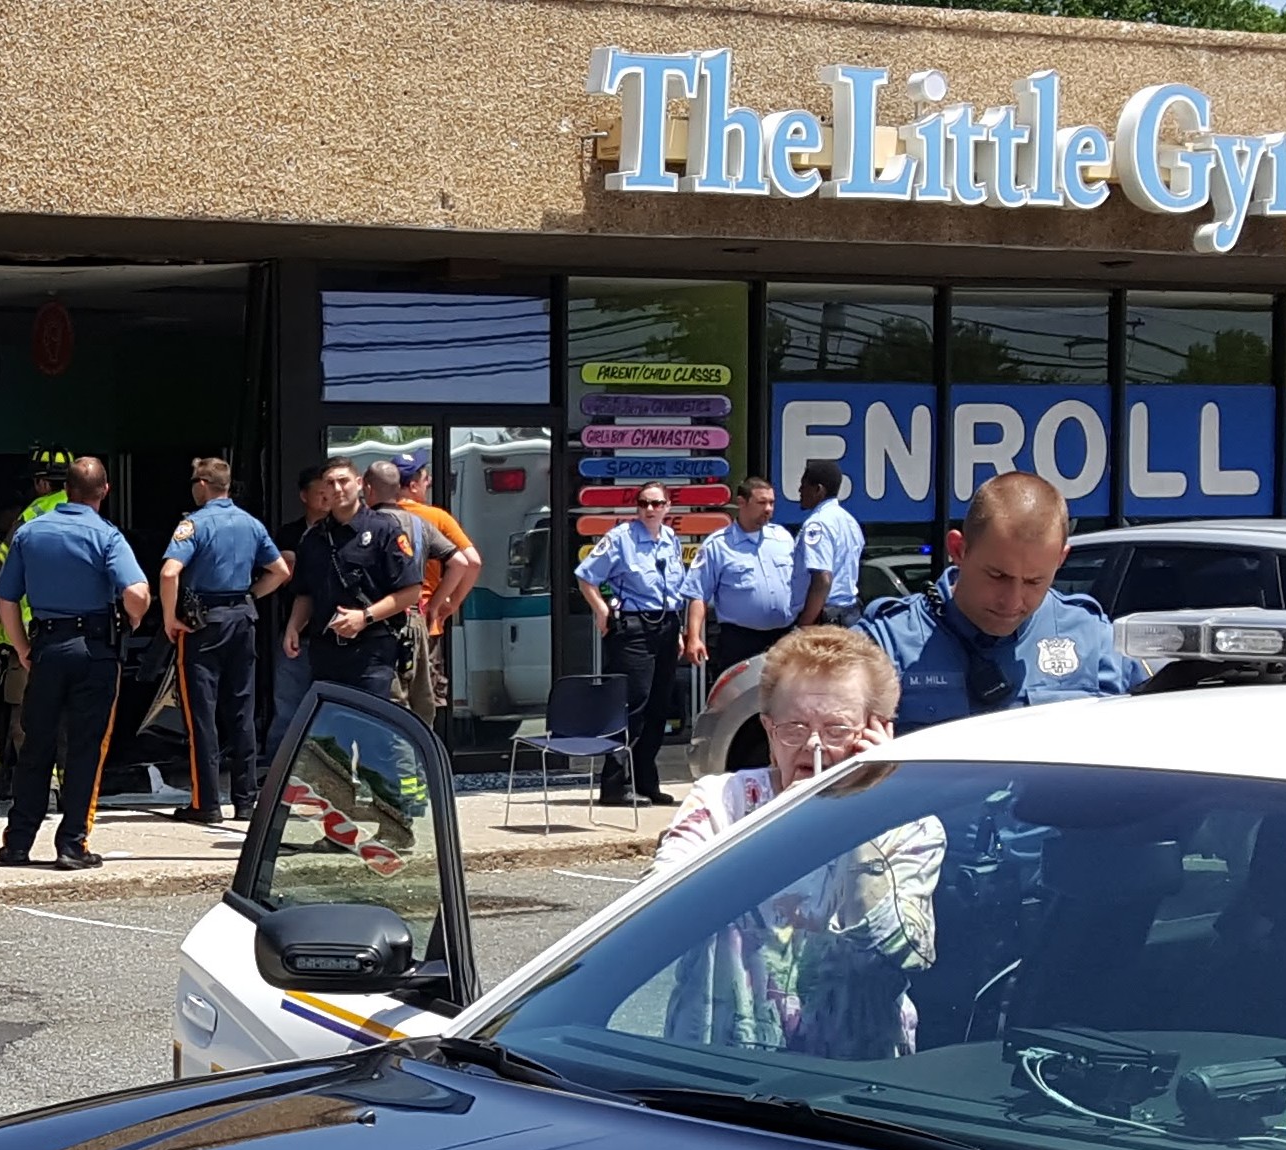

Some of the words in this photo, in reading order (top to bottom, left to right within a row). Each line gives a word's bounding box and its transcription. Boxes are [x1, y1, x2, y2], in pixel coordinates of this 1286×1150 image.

[590, 46, 823, 199] The
[822, 69, 1111, 211] Little
[597, 365, 671, 381] PARENT/CHILD
[673, 366, 722, 383] CLASSES
[631, 429, 710, 446] GYMNASTICS
[781, 400, 1261, 502] ENROLL
[606, 461, 667, 476] SPORTS
[673, 460, 713, 476] SKILLS
[909, 675, 921, 685] M.
[925, 674, 949, 686] HILL
